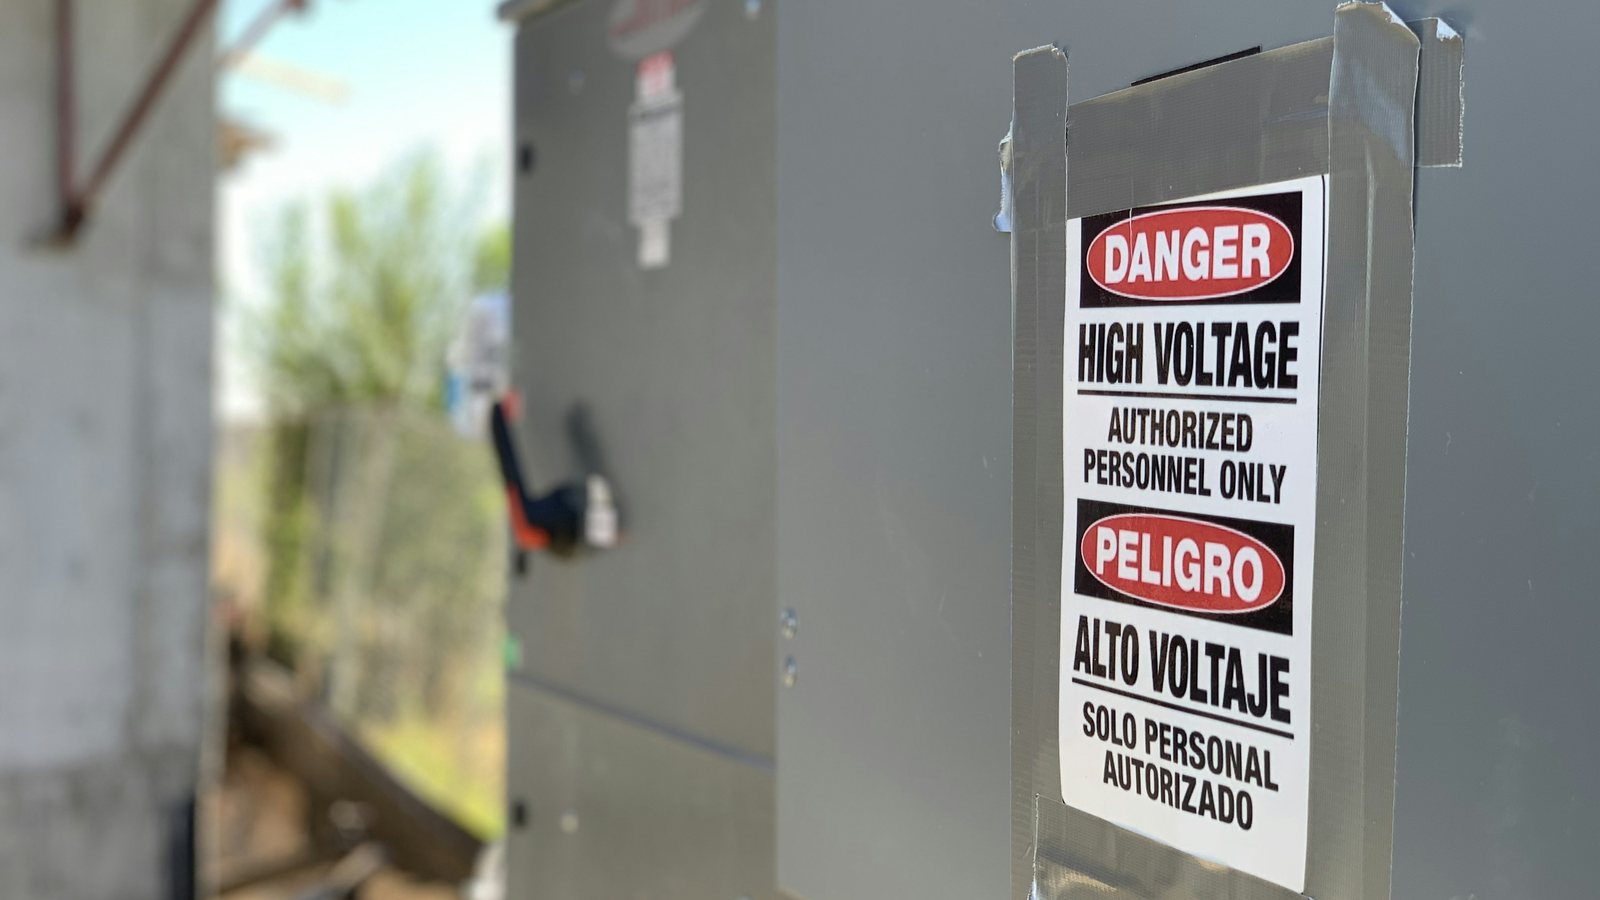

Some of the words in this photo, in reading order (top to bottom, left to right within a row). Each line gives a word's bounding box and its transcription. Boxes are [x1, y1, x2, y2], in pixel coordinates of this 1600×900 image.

[1104, 223, 1271, 284] DANGER
[1077, 322, 1144, 384] HIGH
[1153, 320, 1299, 389] VOLTAGE
[1108, 407, 1253, 452] AUTHORIZED
[1083, 448, 1211, 497] PERSONNEL
[1219, 460, 1287, 504] ONLY
[1096, 526, 1264, 603] PELIGRO
[1073, 614, 1139, 686] ALTO
[1149, 629, 1291, 724] VOLTAJE
[1082, 701, 1137, 750] SOLO
[1145, 718, 1279, 792] PERSONAL
[1103, 750, 1253, 831] AUTORIZADO
